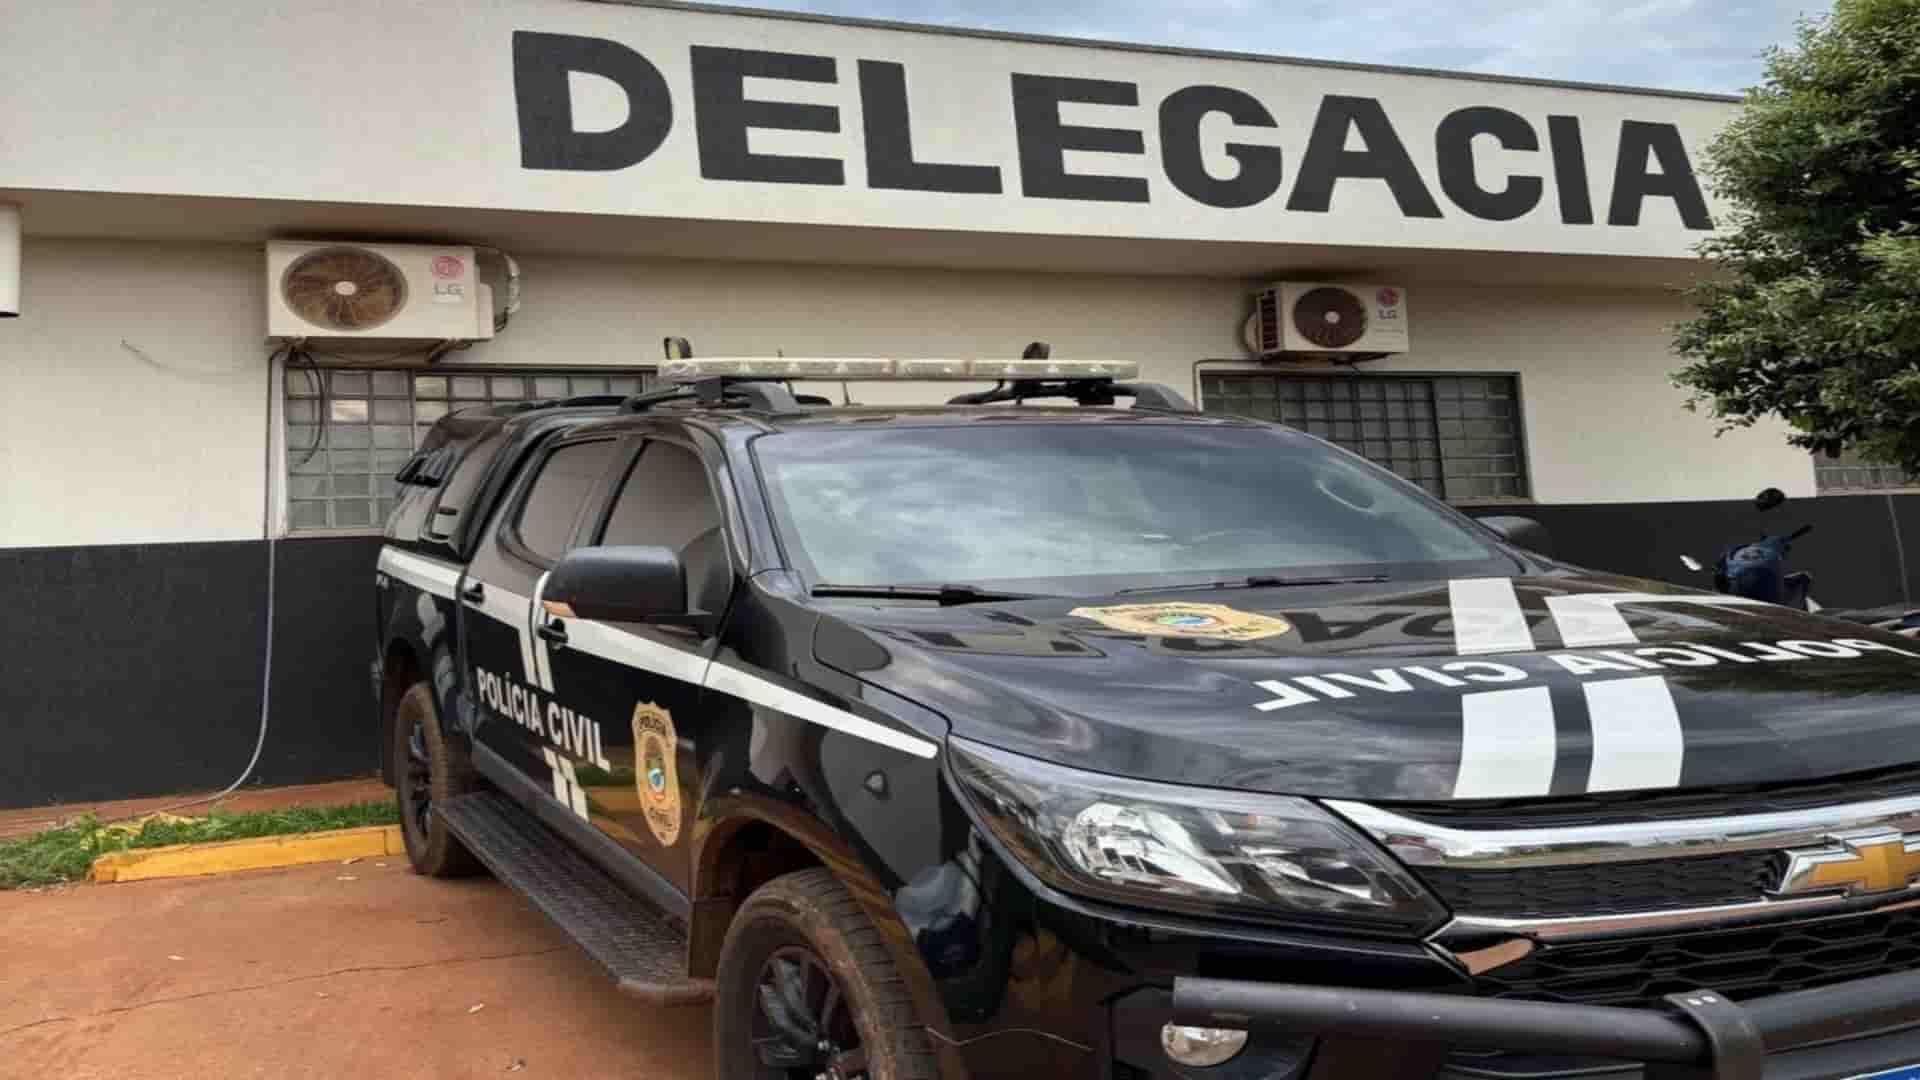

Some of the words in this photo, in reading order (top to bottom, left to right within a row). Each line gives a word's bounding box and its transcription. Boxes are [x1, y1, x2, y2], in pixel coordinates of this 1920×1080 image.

[512, 31, 1712, 230] DELEGACIA
[434, 282, 464, 295] LG
[477, 666, 544, 736] POLÍCIA
[547, 701, 611, 773] CIVIL
